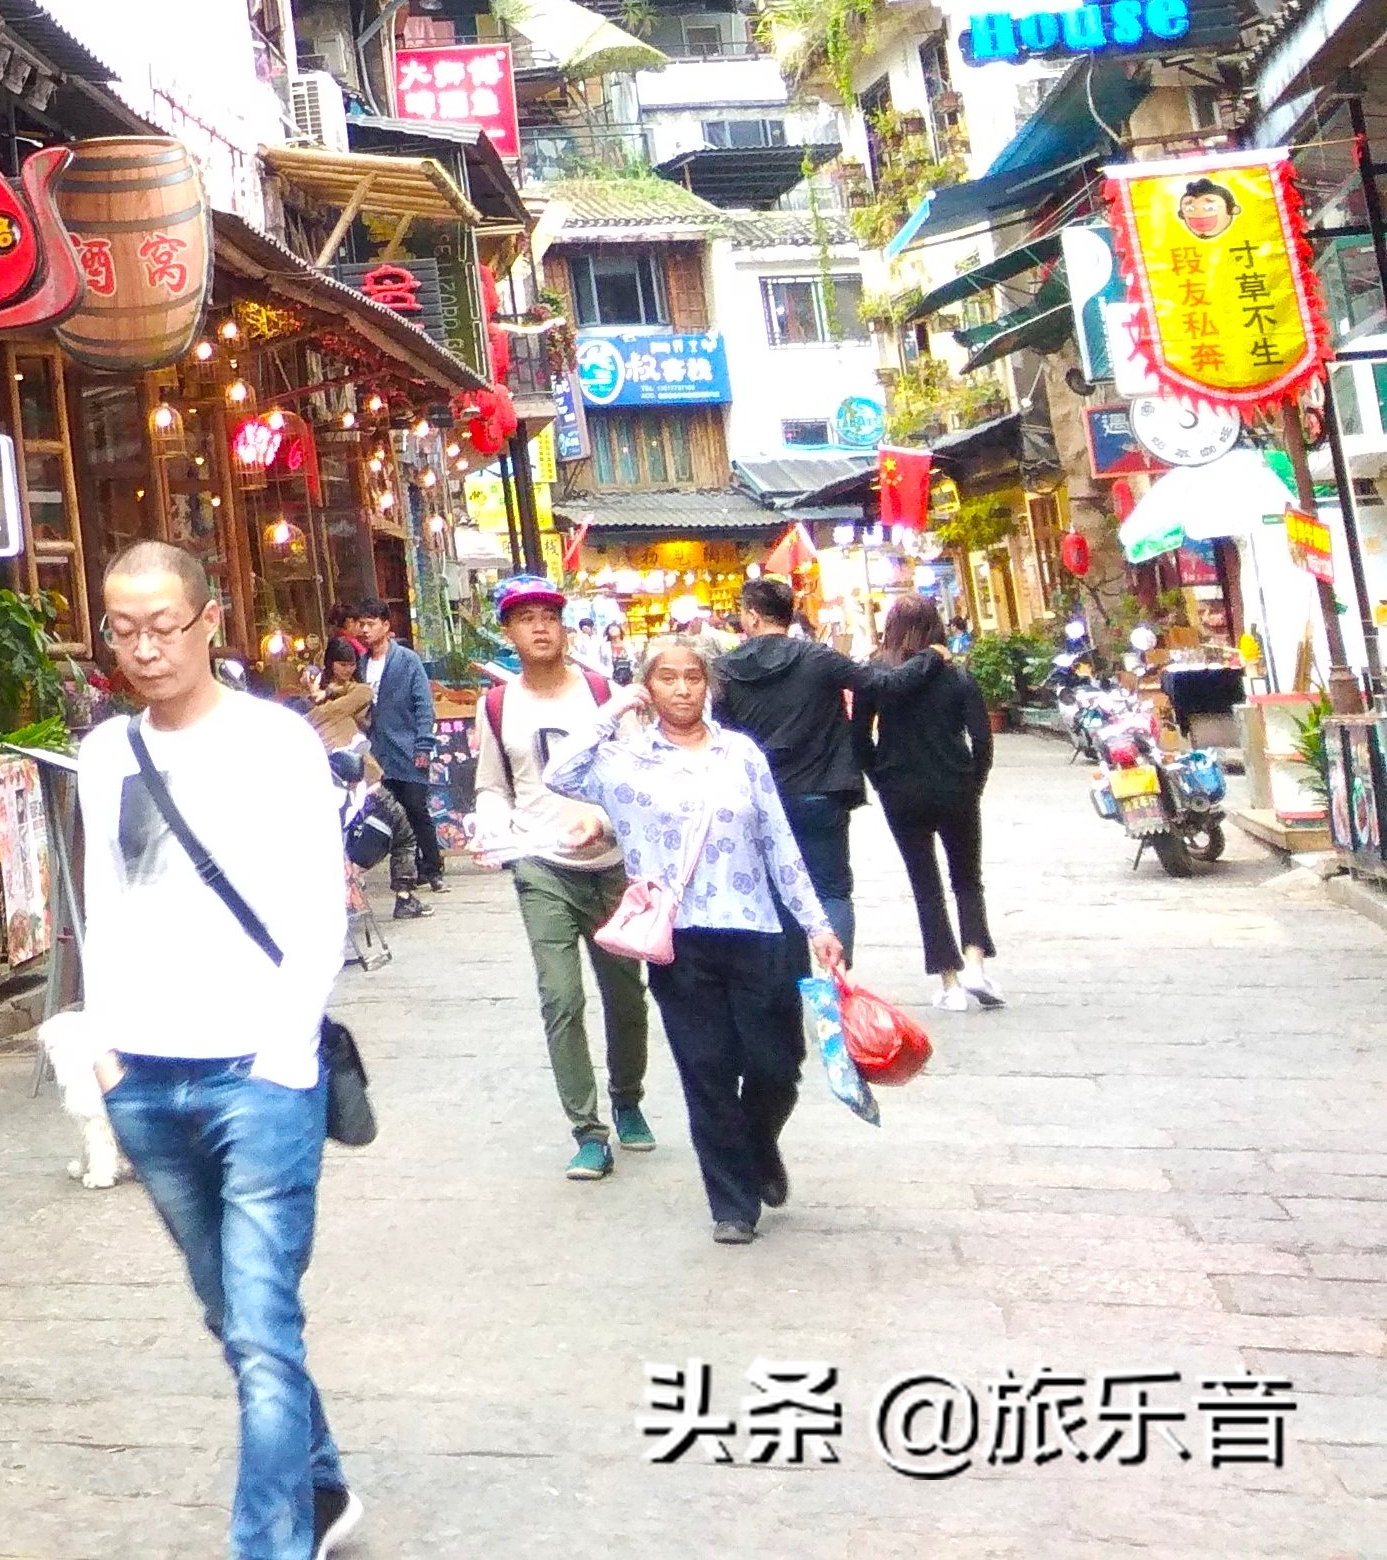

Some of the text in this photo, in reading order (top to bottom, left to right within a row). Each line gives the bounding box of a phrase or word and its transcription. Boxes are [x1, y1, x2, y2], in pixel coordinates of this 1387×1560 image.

[1170, 246, 1225, 372] 段友私奔
[1229, 240, 1284, 367] 寸草不生
